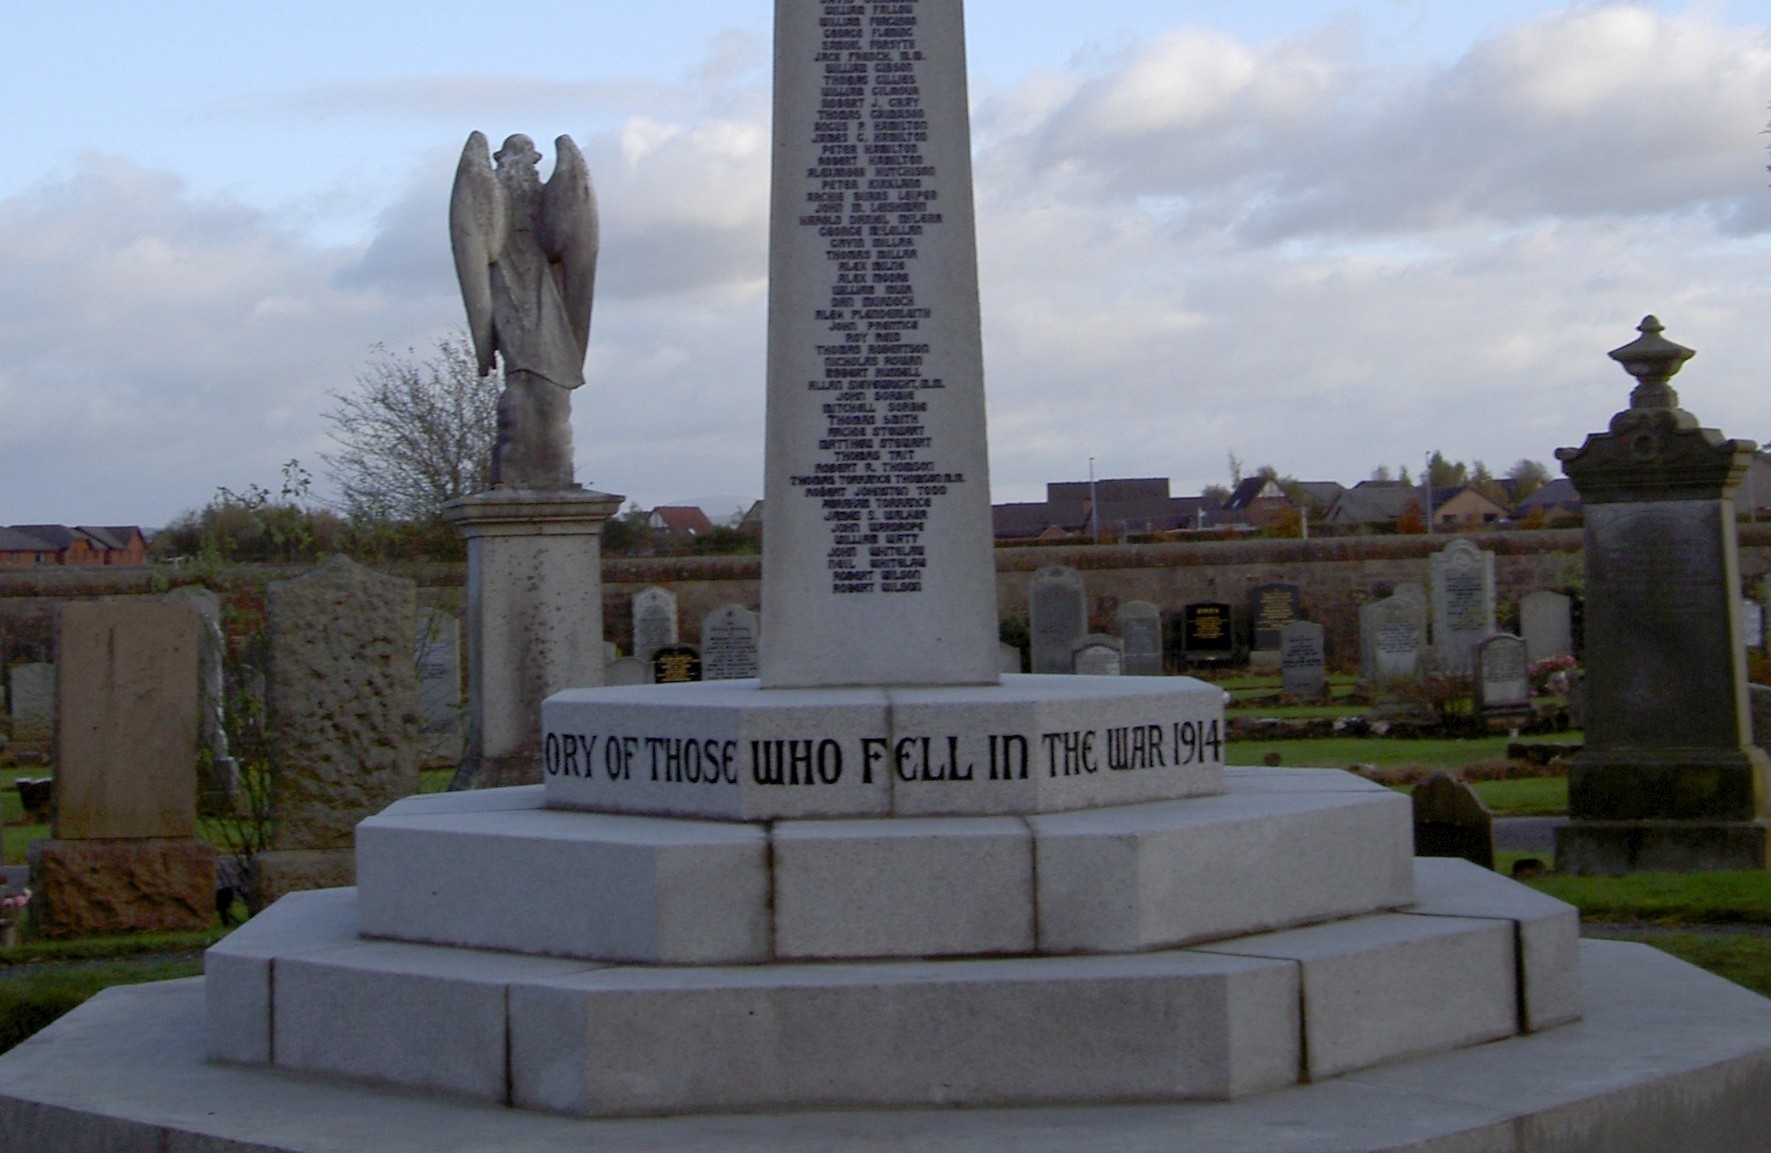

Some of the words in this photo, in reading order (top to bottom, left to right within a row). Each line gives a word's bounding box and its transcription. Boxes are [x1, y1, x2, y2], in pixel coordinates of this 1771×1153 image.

[605, 735, 638, 781] OF
[645, 737, 738, 785] THOSE
[751, 738, 843, 785] WHO
[860, 736, 973, 784] FELL
[988, 734, 1029, 780] IN
[1042, 730, 1098, 778] THE
[1107, 724, 1166, 771] WAR
[1173, 720, 1223, 766] 1914
